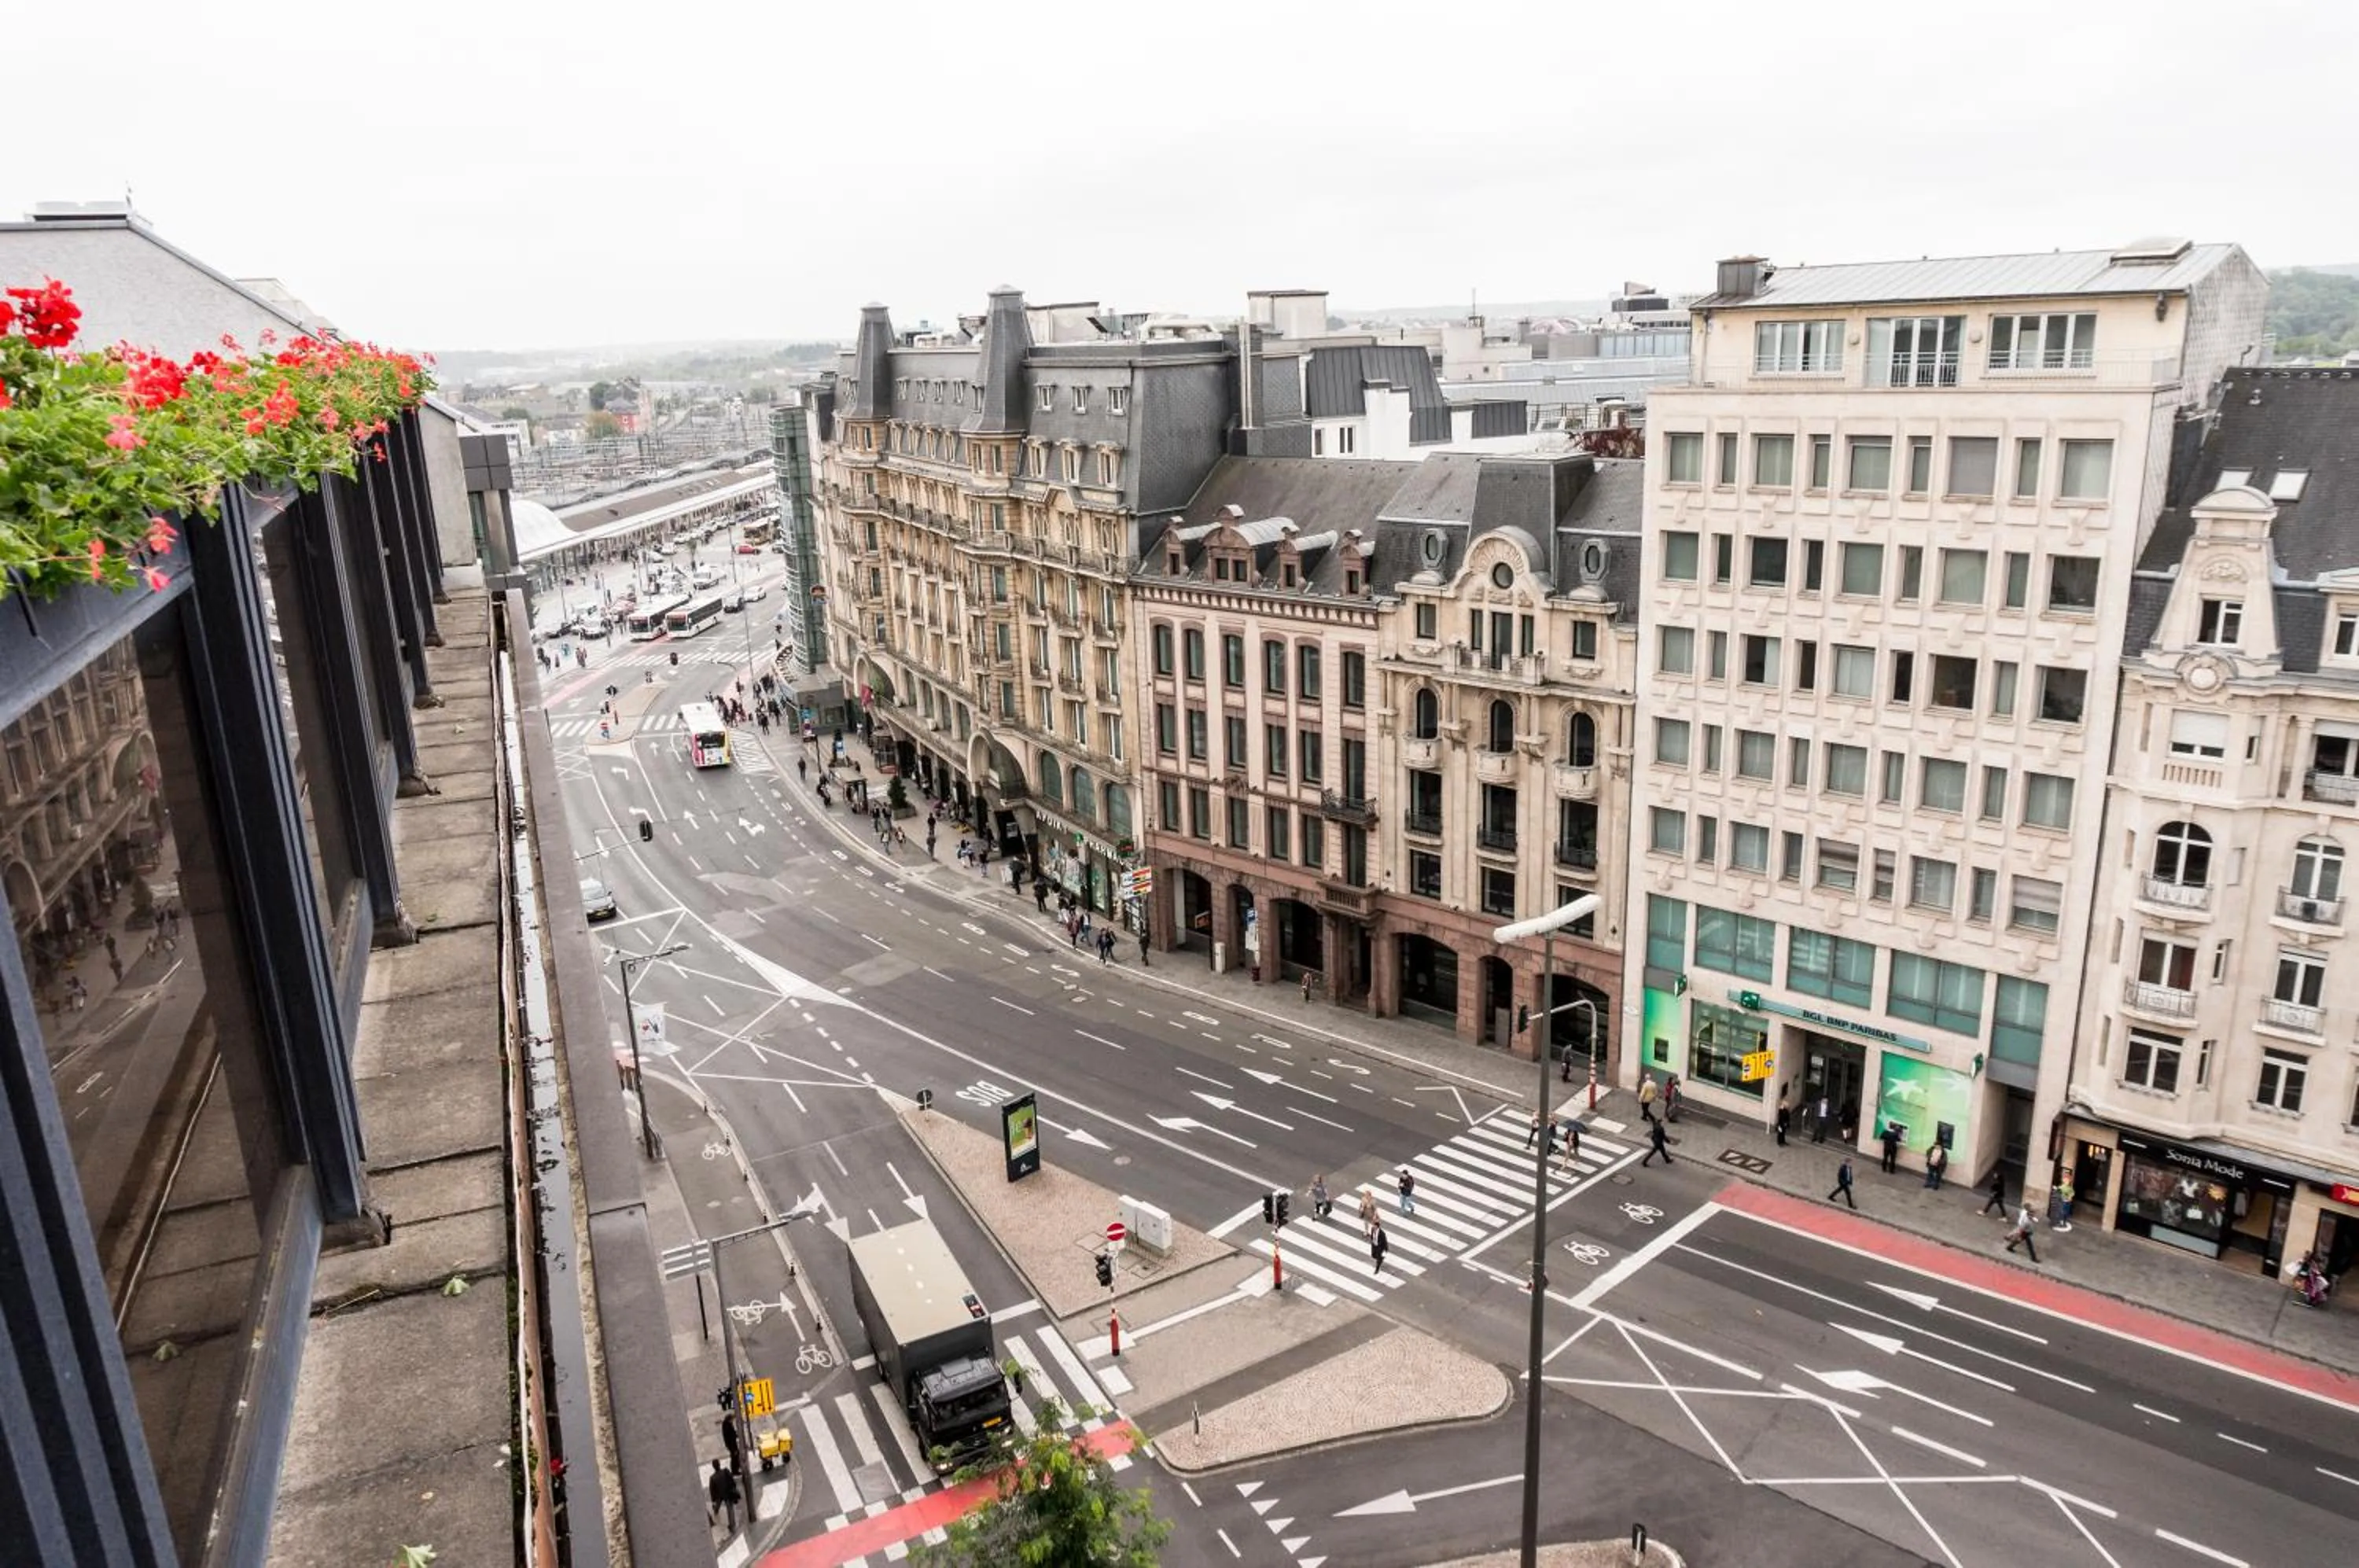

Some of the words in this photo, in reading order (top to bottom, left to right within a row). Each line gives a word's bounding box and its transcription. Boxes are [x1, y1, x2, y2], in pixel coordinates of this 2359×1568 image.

[1827, 1016, 1849, 1028] BNP
[1851, 1022, 1897, 1042] PARIBAS
[955, 1080, 1014, 1107] BUS
[2166, 1148, 2202, 1169] Sonia
[2203, 1158, 2245, 1180] Mode
